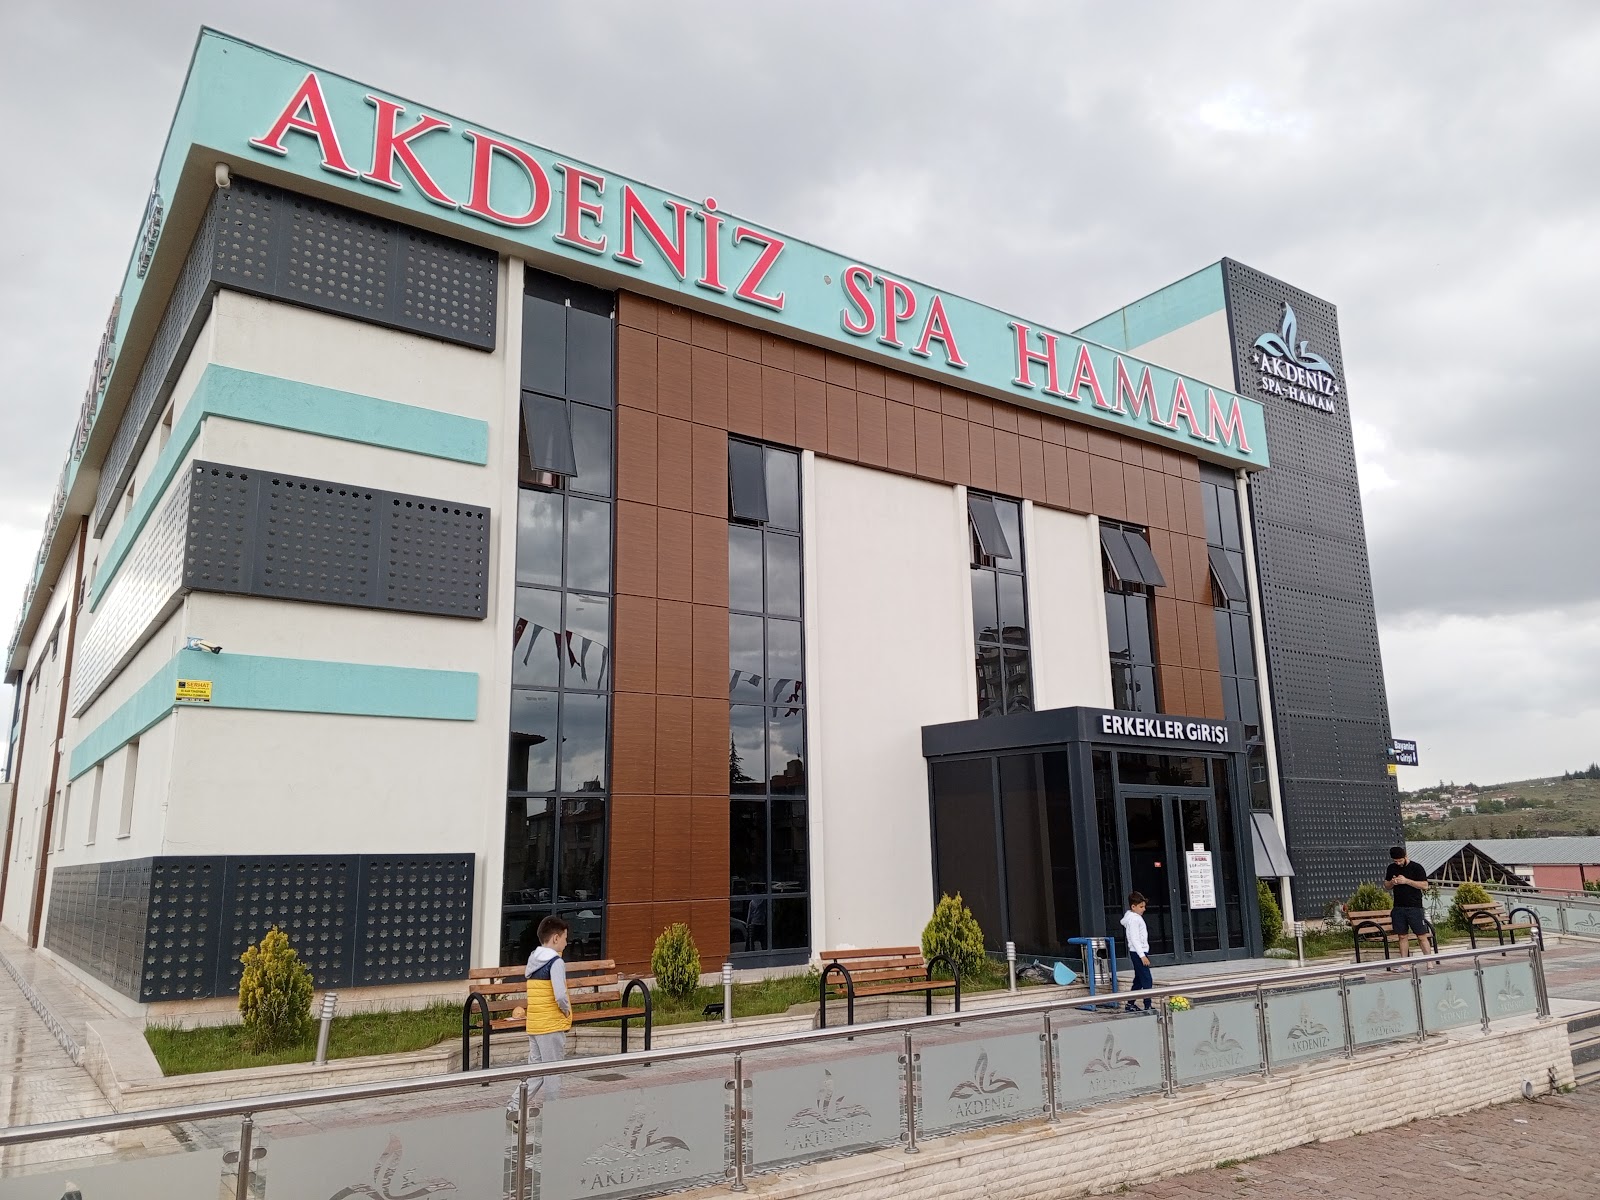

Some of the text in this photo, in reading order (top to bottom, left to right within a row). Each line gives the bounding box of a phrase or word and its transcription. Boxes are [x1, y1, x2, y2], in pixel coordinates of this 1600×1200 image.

[248, 71, 786, 312] AKDENİZ
[840, 264, 968, 369] SPA
[1008, 321, 1253, 454] HAMAM
[1260, 353, 1335, 396] AKDENİZ
[1102, 714, 1185, 739] ERKEKLER
